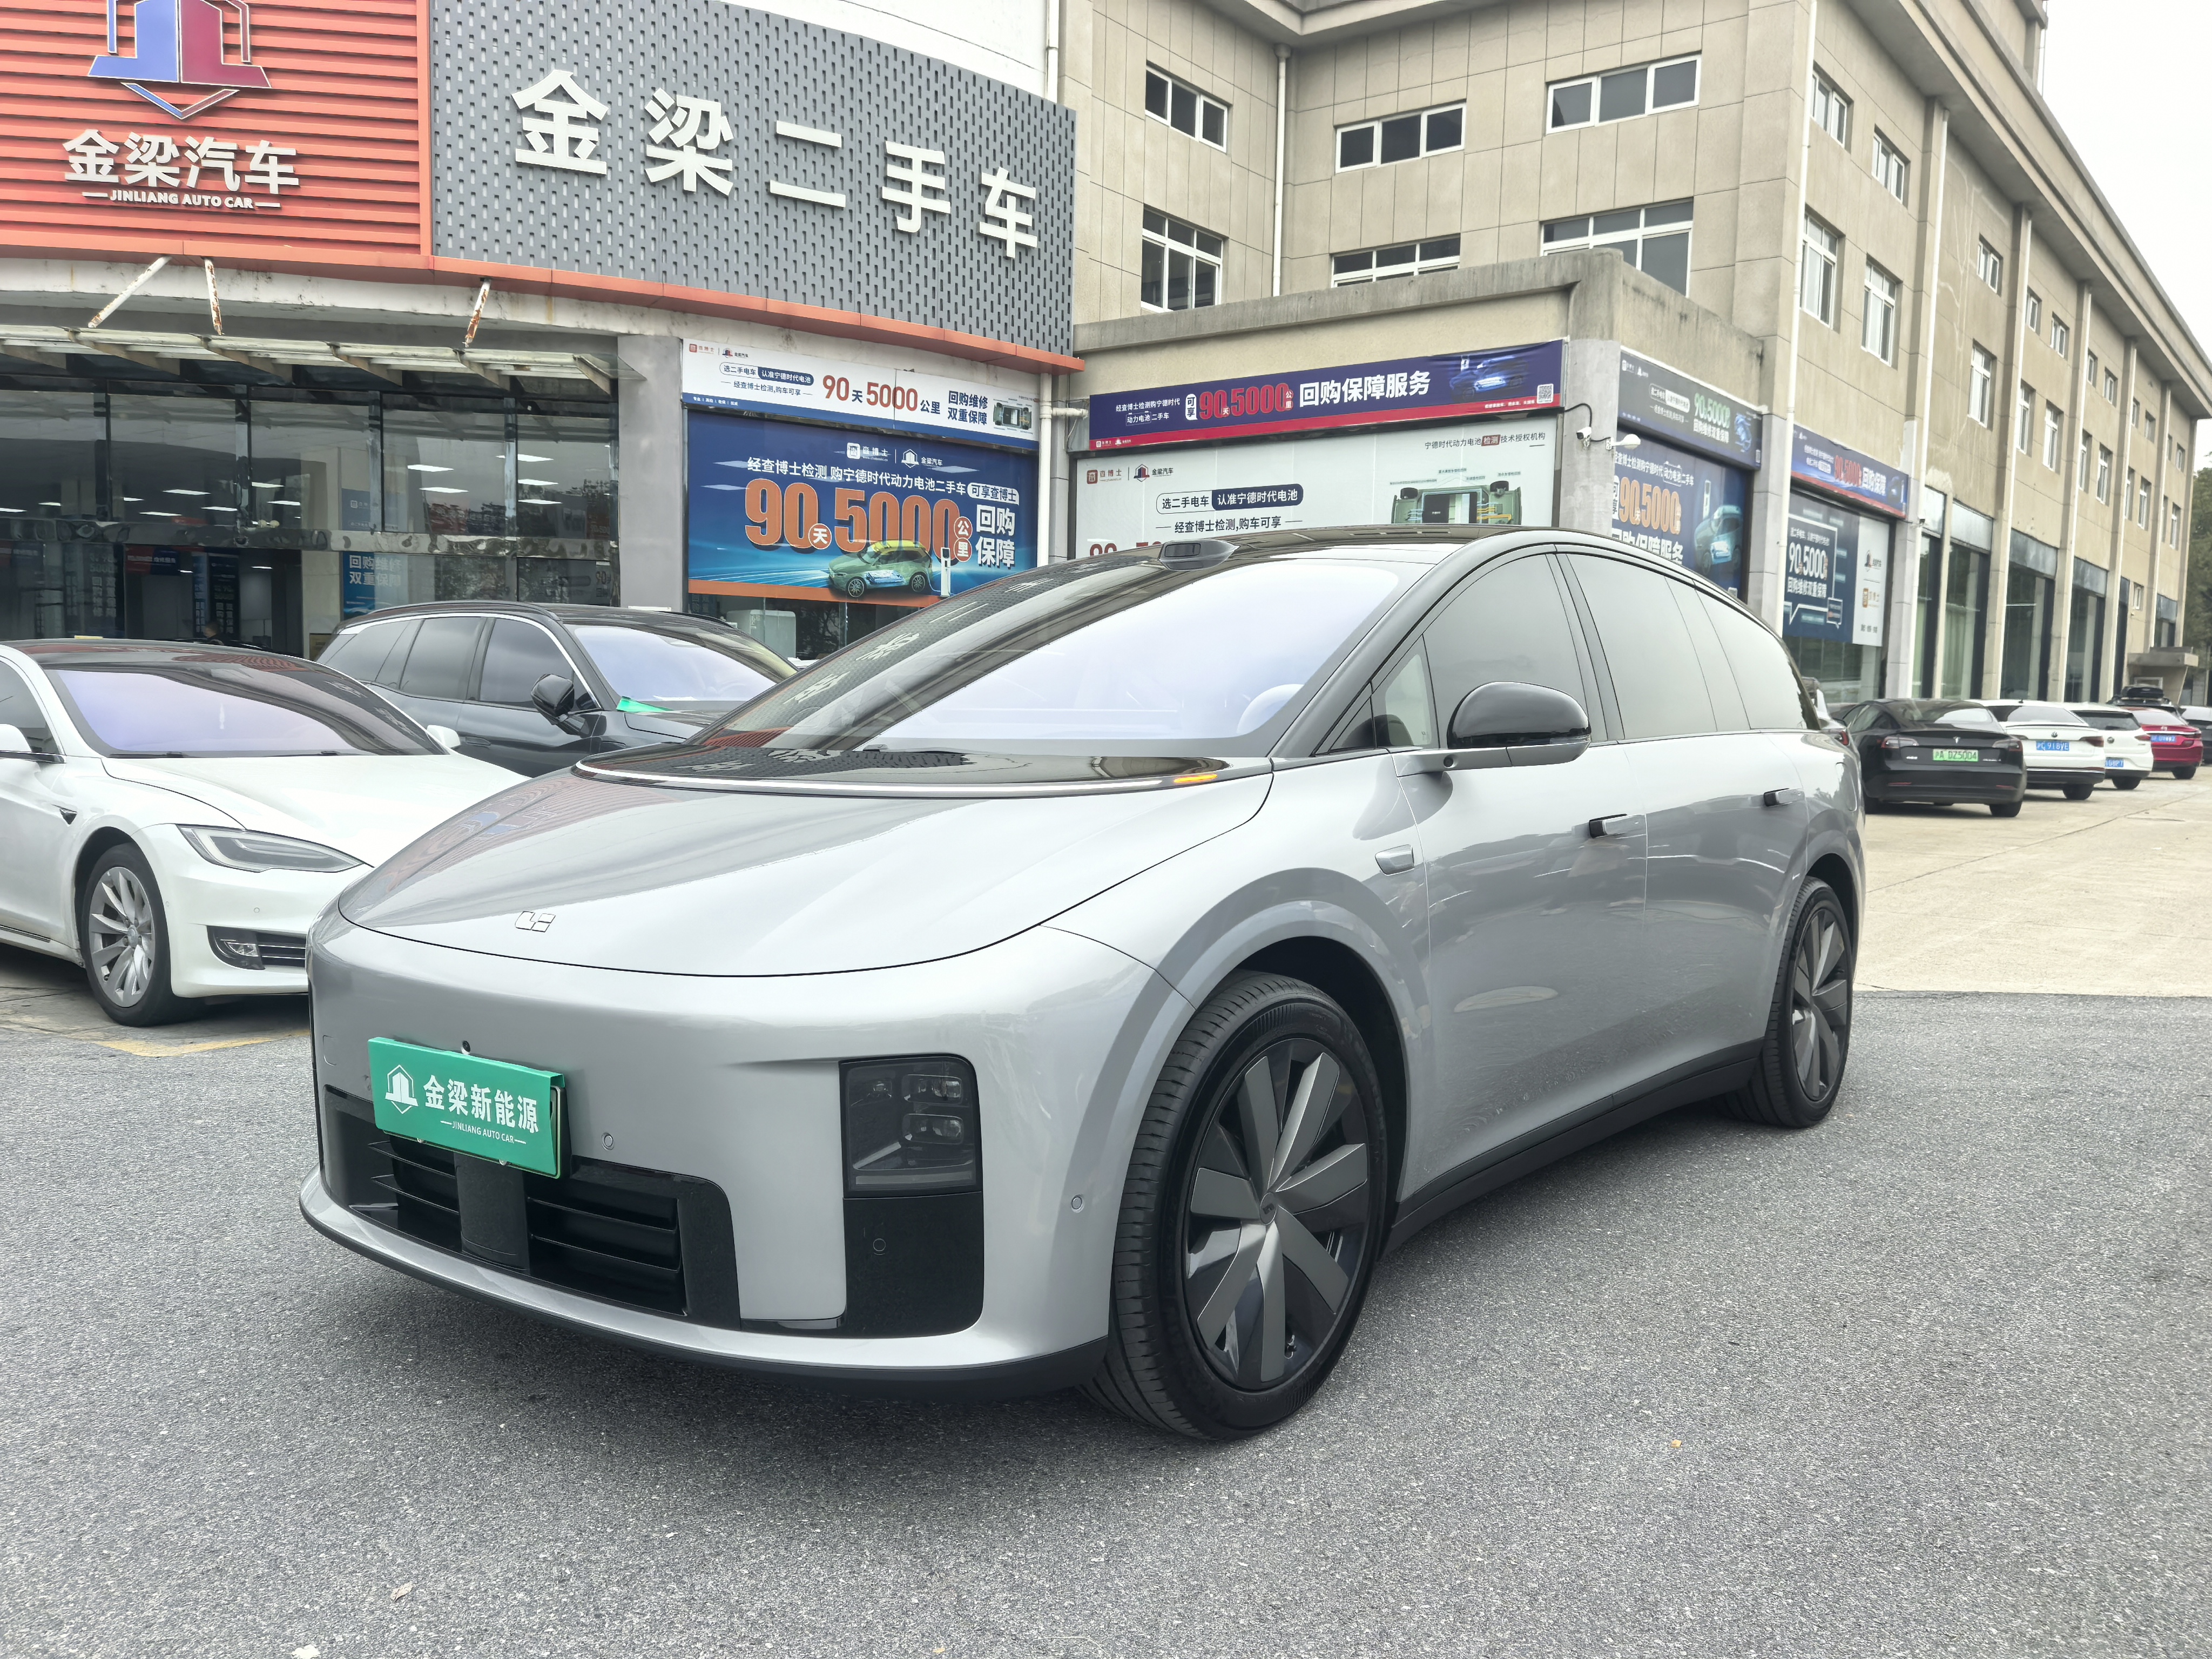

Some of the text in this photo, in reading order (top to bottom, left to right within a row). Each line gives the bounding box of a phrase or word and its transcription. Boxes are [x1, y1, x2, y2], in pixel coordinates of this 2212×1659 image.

[63, 129, 300, 195] 金梁汽车
[511, 69, 1038, 259] 金梁二手车
[110, 188, 254, 209] JINLIANG AUTO CAR
[724, 365, 811, 383] 选二手电车 认准宁德时代电池
[948, 390, 989, 410] 回购维修
[1299, 370, 1431, 407] 回购保障服务
[947, 407, 988, 426] 双重保障
[747, 456, 967, 496] 经查博士检测 购宁德时代动力电池二手车
[971, 485, 1017, 503] 可享查博士
[1162, 489, 1298, 510] 选二手电车 认准宁德时代电池
[976, 504, 1016, 536] 回购
[975, 535, 1016, 568] 保障
[423, 1075, 539, 1134] 金梁新能源
[452, 1121, 514, 1144] JINLIANG AUTO CAR
